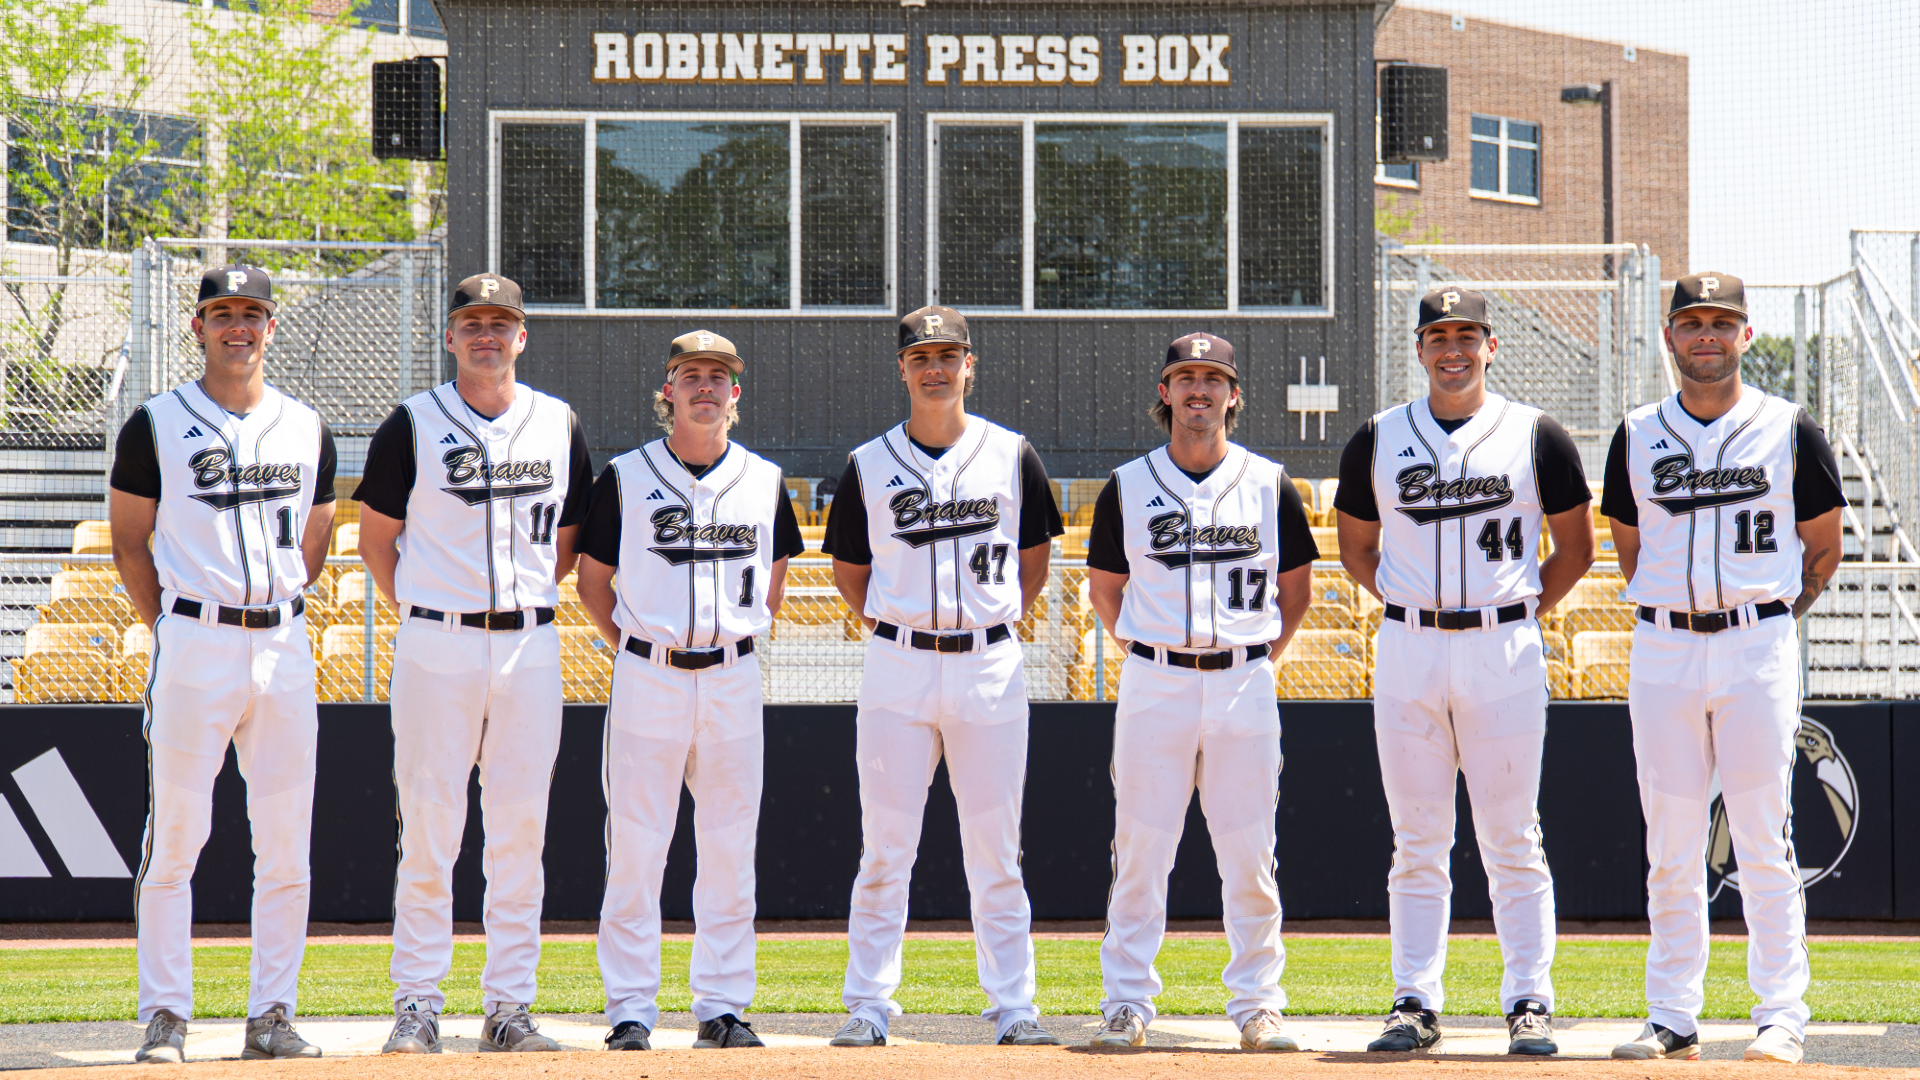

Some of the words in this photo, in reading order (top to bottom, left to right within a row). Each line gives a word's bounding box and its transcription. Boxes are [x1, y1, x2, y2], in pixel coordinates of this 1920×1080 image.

[592, 32, 907, 83] ROBINETTE
[925, 33, 1100, 85] PRESS
[1121, 34, 1231, 86] BOX
[226, 271, 247, 292] P
[480, 278, 500, 299] P
[1699, 277, 1720, 300] P
[1441, 291, 1461, 314] P
[695, 334, 715, 351] P
[923, 314, 944, 337] P
[1190, 339, 1211, 359] P
[188, 446, 301, 490] Braves
[442, 445, 554, 485] Braves
[1396, 463, 1514, 505] Braves
[1651, 453, 1768, 495] Braves
[276, 505, 295, 549] 1
[529, 502, 557, 545] 11
[650, 504, 757, 545] Braves
[888, 487, 999, 529] Braves
[1147, 510, 1261, 551] Braves
[1477, 517, 1524, 562] 44
[1734, 510, 1778, 554] 12
[969, 543, 1009, 584] 47
[738, 565, 756, 607] 1
[1228, 567, 1268, 611] 17
